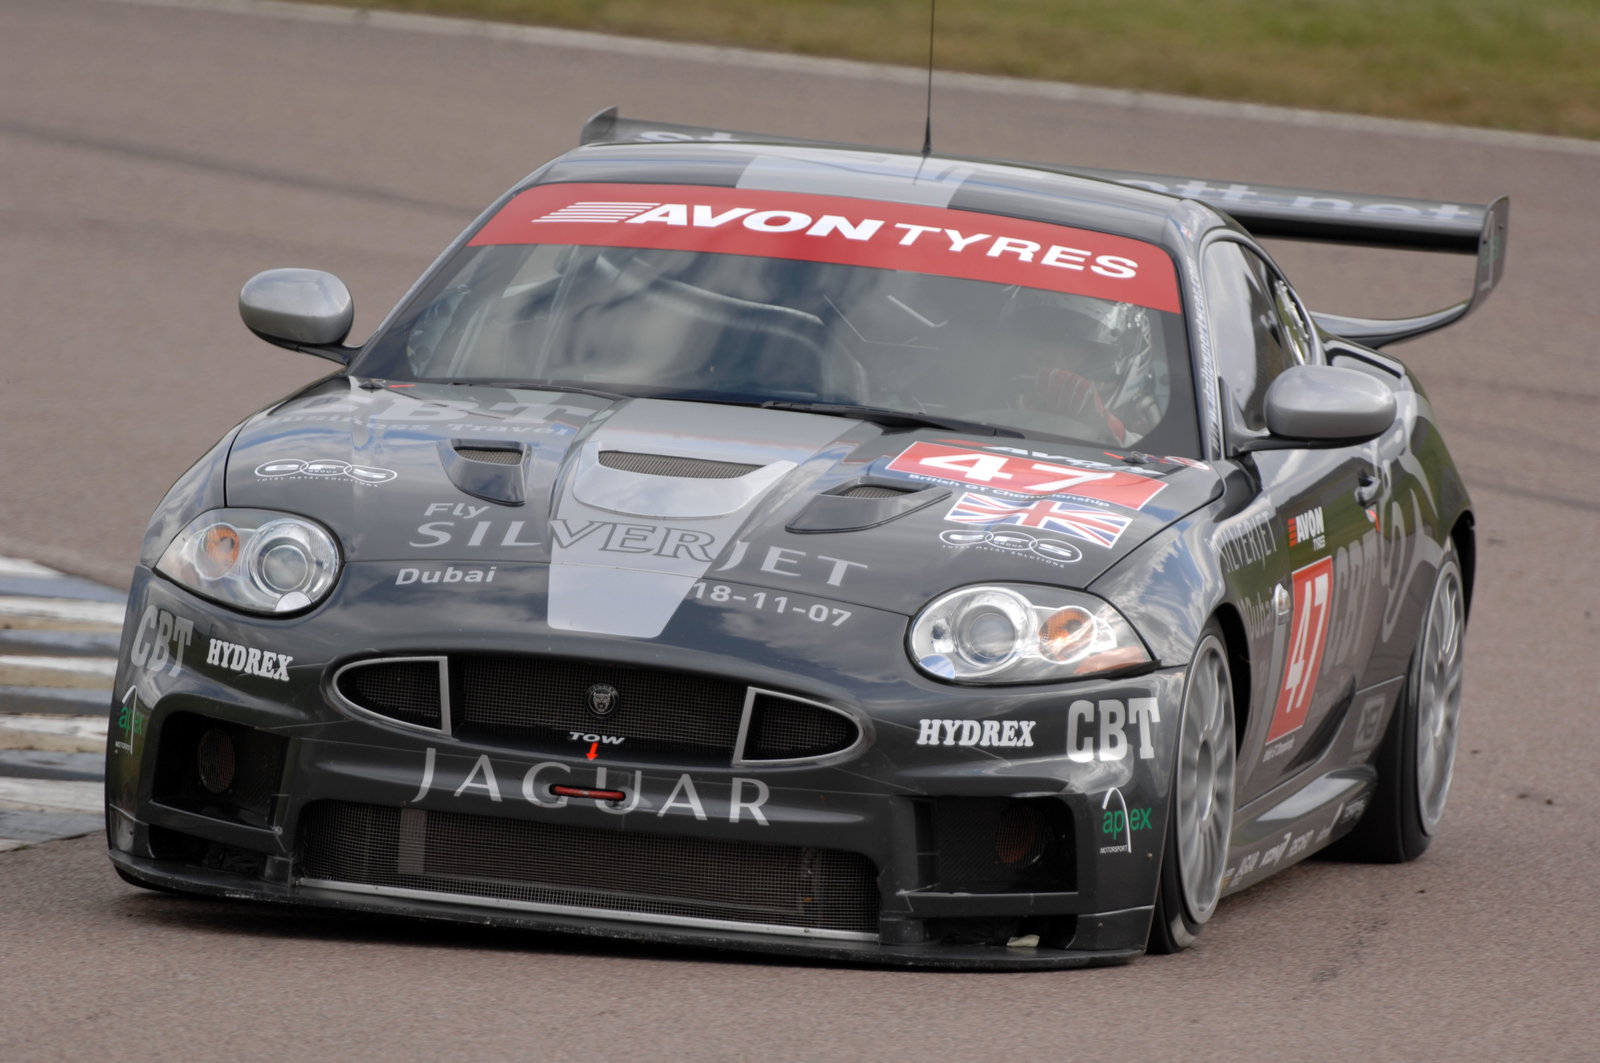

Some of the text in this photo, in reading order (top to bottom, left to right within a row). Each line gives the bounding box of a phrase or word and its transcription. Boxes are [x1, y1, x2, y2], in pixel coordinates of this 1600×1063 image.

[627, 202, 1139, 279] AVON TYRES
[447, 422, 570, 437] Travel
[908, 473, 960, 487] British
[965, 483, 989, 493] GT
[919, 453, 1117, 492] 47
[423, 502, 491, 519] Fly
[1295, 506, 1325, 544] AVON
[409, 519, 869, 587] SILVERJET
[1216, 510, 1278, 574] SILVERJET
[396, 566, 497, 586] Dubai
[693, 581, 853, 628] 18-11-07
[130, 604, 195, 678] CBT
[206, 637, 294, 683] HYDREX
[1284, 572, 1329, 714] 47
[569, 731, 626, 745] TOW
[916, 718, 1037, 747] HYDREX
[1066, 697, 1161, 763] CBT
[411, 747, 771, 827] JAGUAR
[1103, 807, 1153, 840] apex
